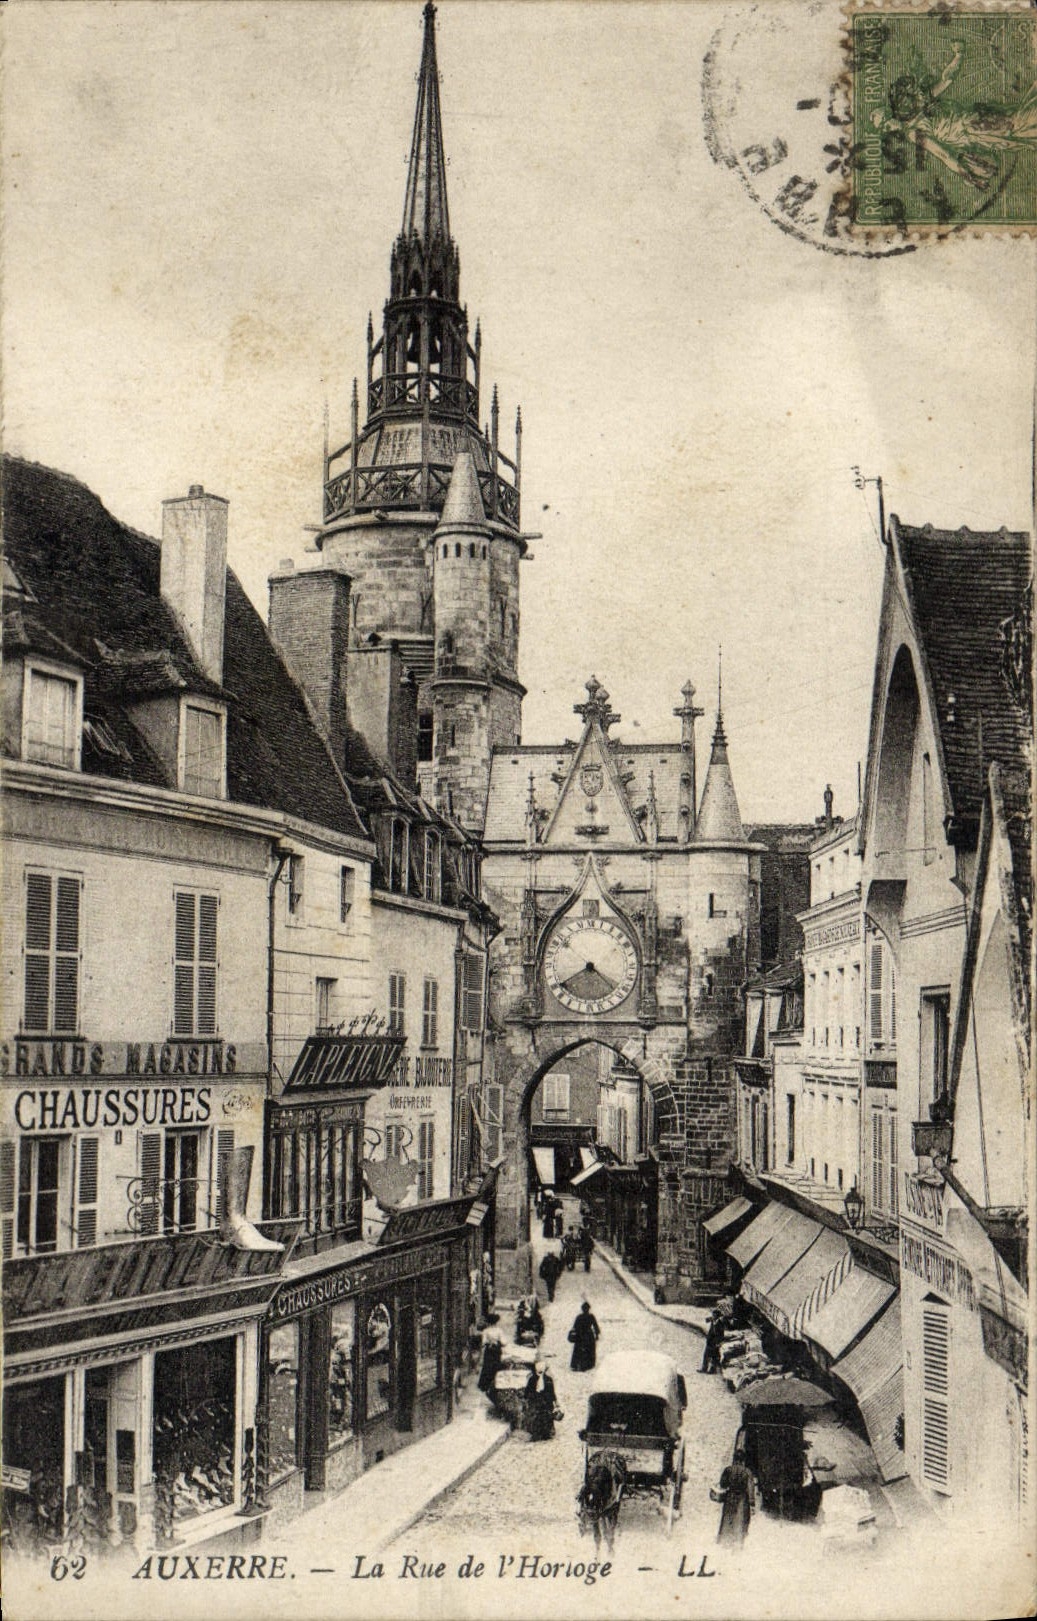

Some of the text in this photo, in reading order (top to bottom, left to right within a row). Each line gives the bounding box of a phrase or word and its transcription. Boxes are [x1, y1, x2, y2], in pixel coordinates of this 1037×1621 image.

[126, 1042, 237, 1075] MAGASINS
[14, 1087, 212, 1131] CHAUSSURES
[277, 1275, 351, 1317] CHAUSSURES
